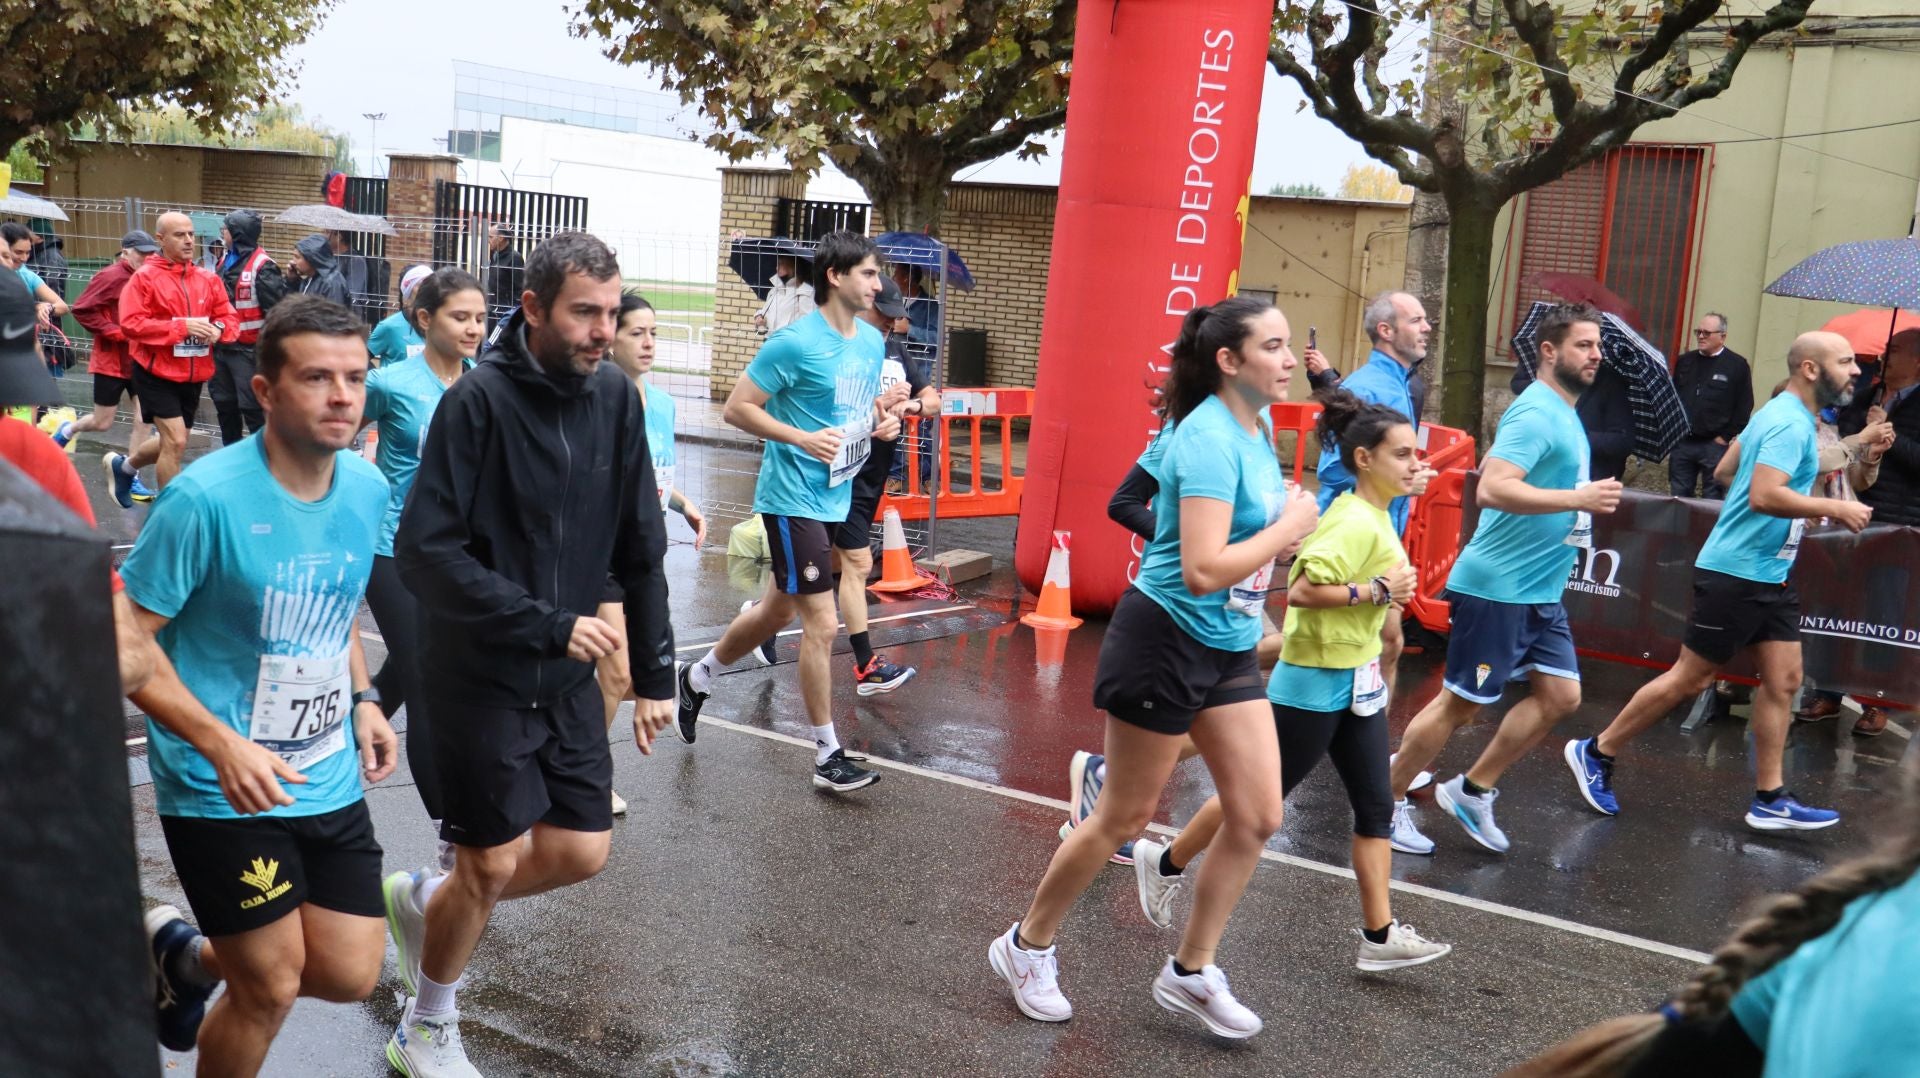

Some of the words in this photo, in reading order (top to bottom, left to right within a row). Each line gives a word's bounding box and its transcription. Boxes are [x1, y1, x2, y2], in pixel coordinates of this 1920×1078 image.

[1175, 28, 1235, 245] DEPORTES
[1165, 262, 1202, 316] DE
[845, 437, 866, 465] 1110
[1904, 629, 1920, 643] D
[290, 688, 341, 739] 736
[240, 894, 267, 910] CAJA
[265, 879, 293, 901] RURAL
